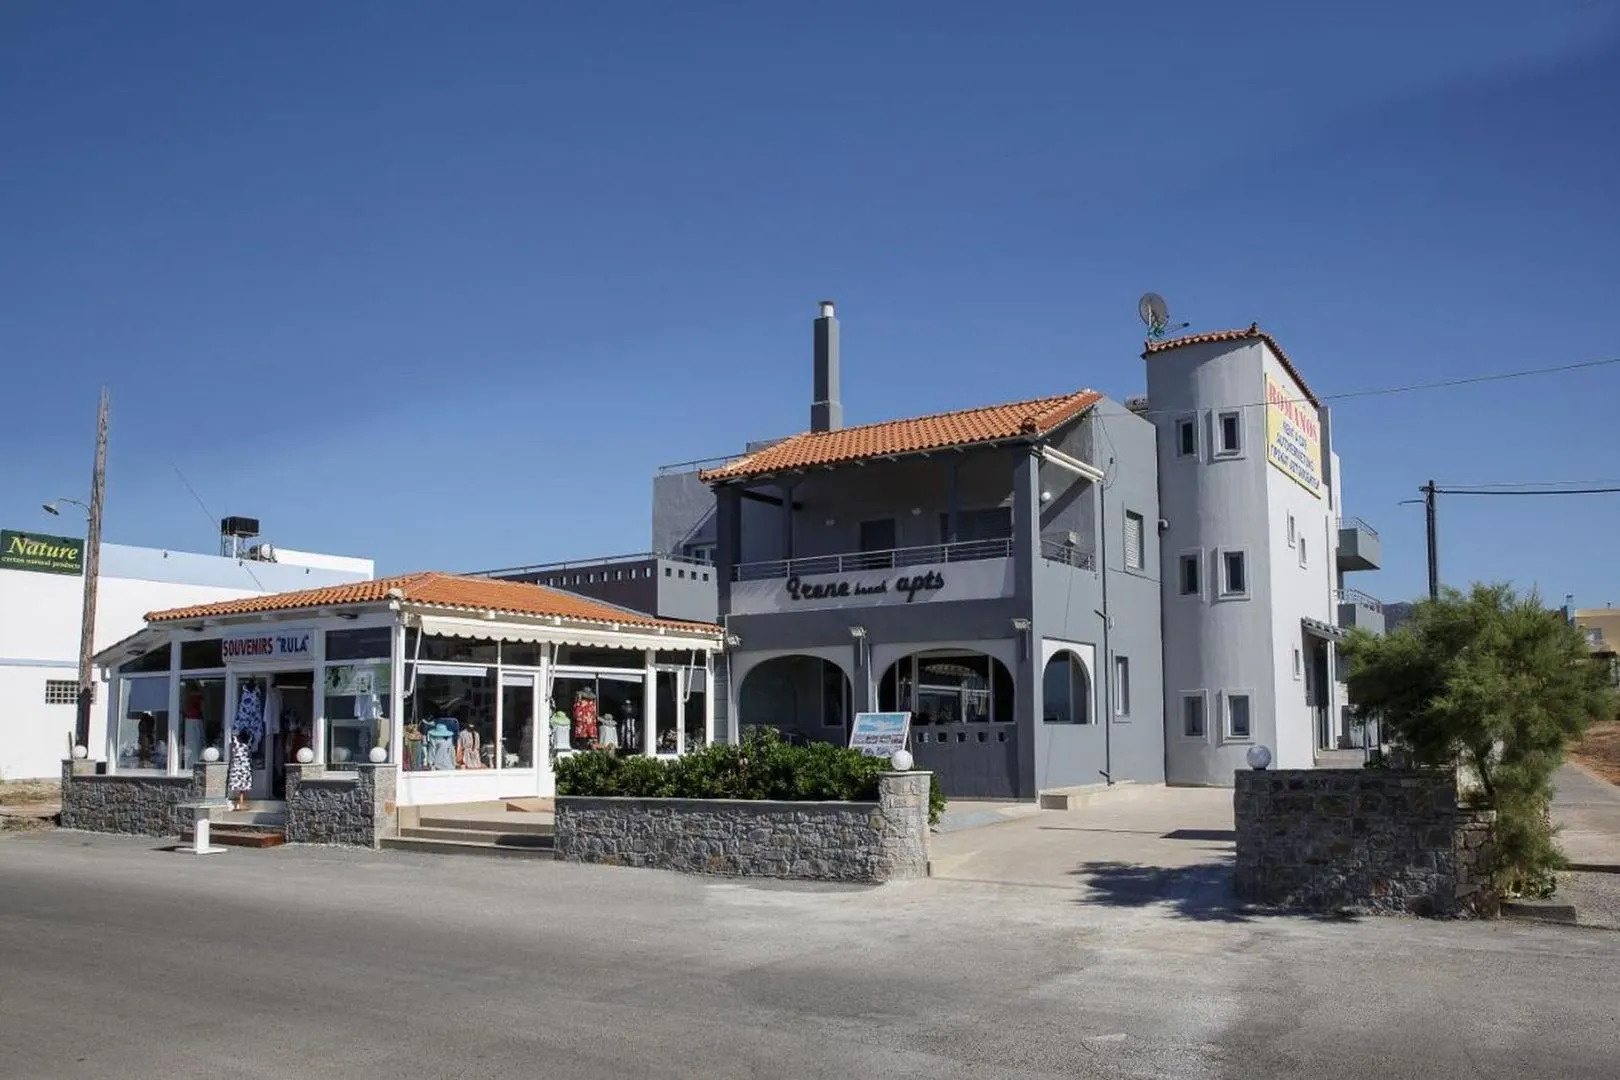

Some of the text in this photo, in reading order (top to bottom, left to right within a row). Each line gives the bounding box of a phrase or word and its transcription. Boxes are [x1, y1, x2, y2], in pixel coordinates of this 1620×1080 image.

[1269, 380, 1318, 441] ROMANOS
[5, 536, 79, 560] Nature
[896, 570, 945, 603] apts
[223, 637, 273, 657] SOUVENIRS
